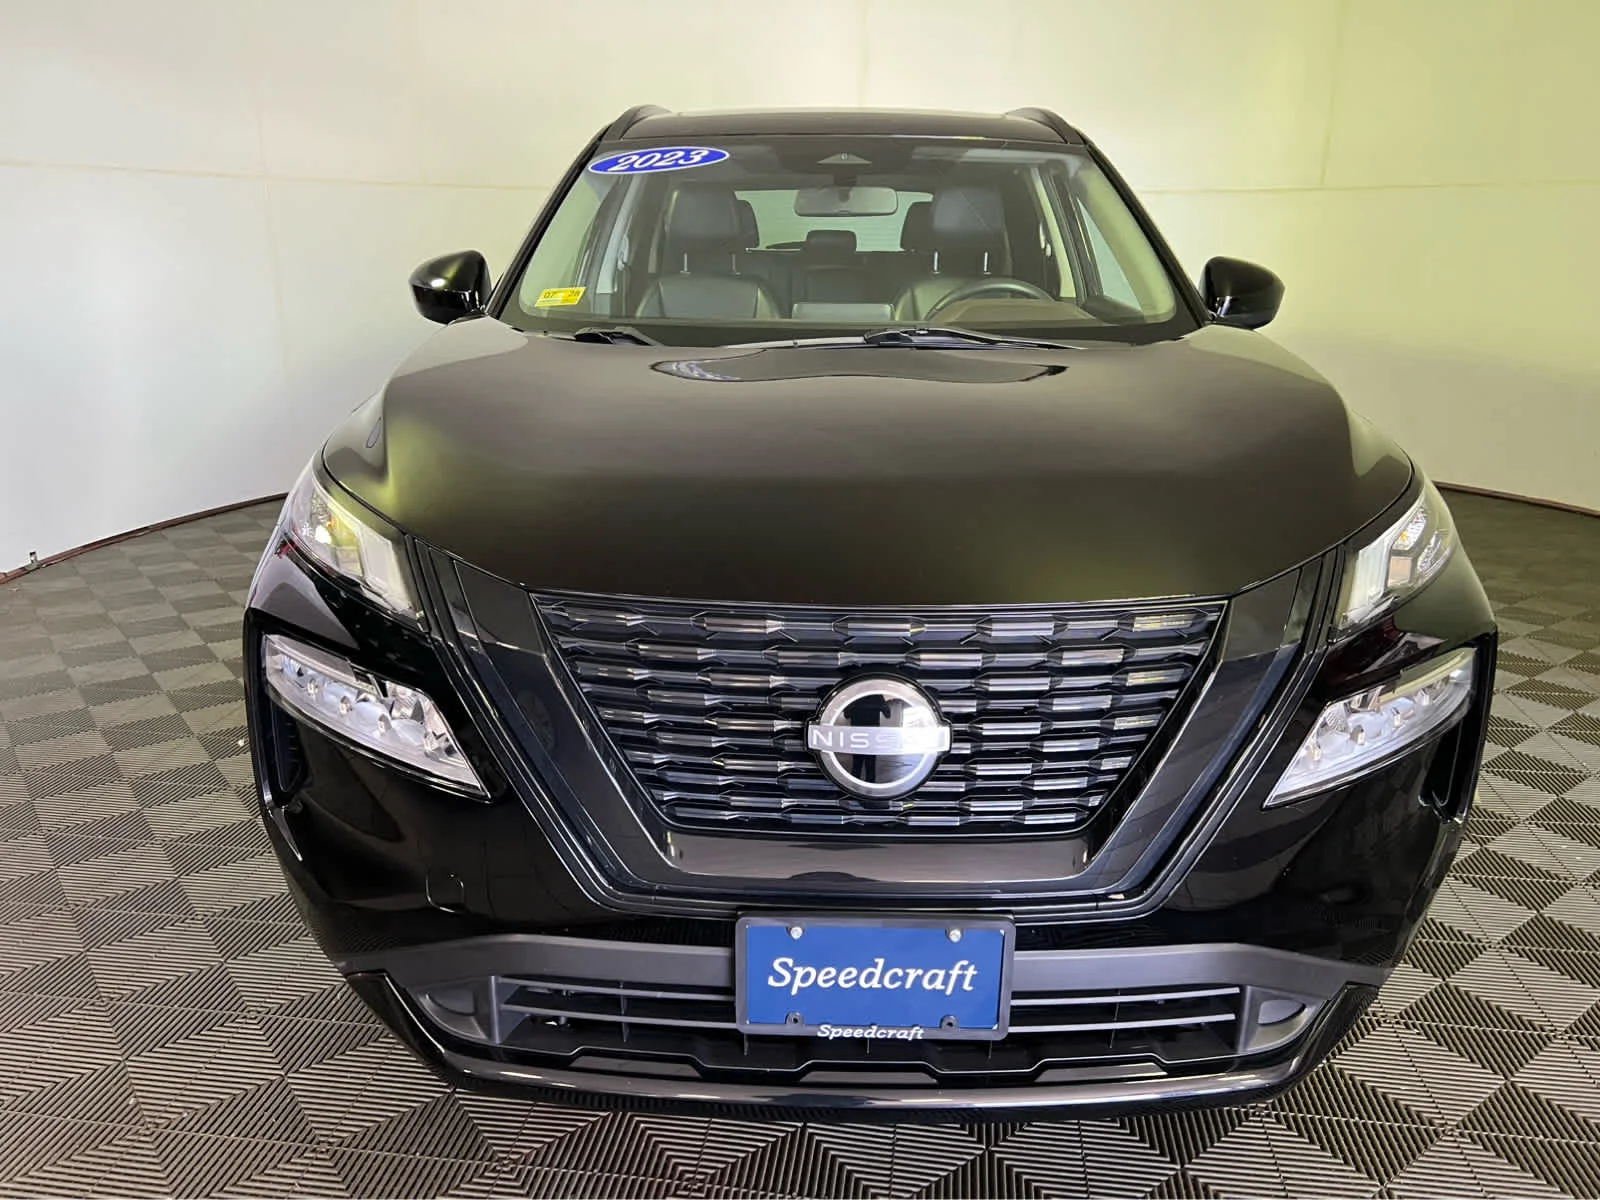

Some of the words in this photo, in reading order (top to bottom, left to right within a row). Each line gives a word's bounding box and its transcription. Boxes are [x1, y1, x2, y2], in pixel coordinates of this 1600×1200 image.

[607, 149, 711, 172] 2023
[812, 729, 946, 748] NISS
[767, 957, 978, 996] Speedcraft
[816, 1024, 925, 1041] Speedcraft
